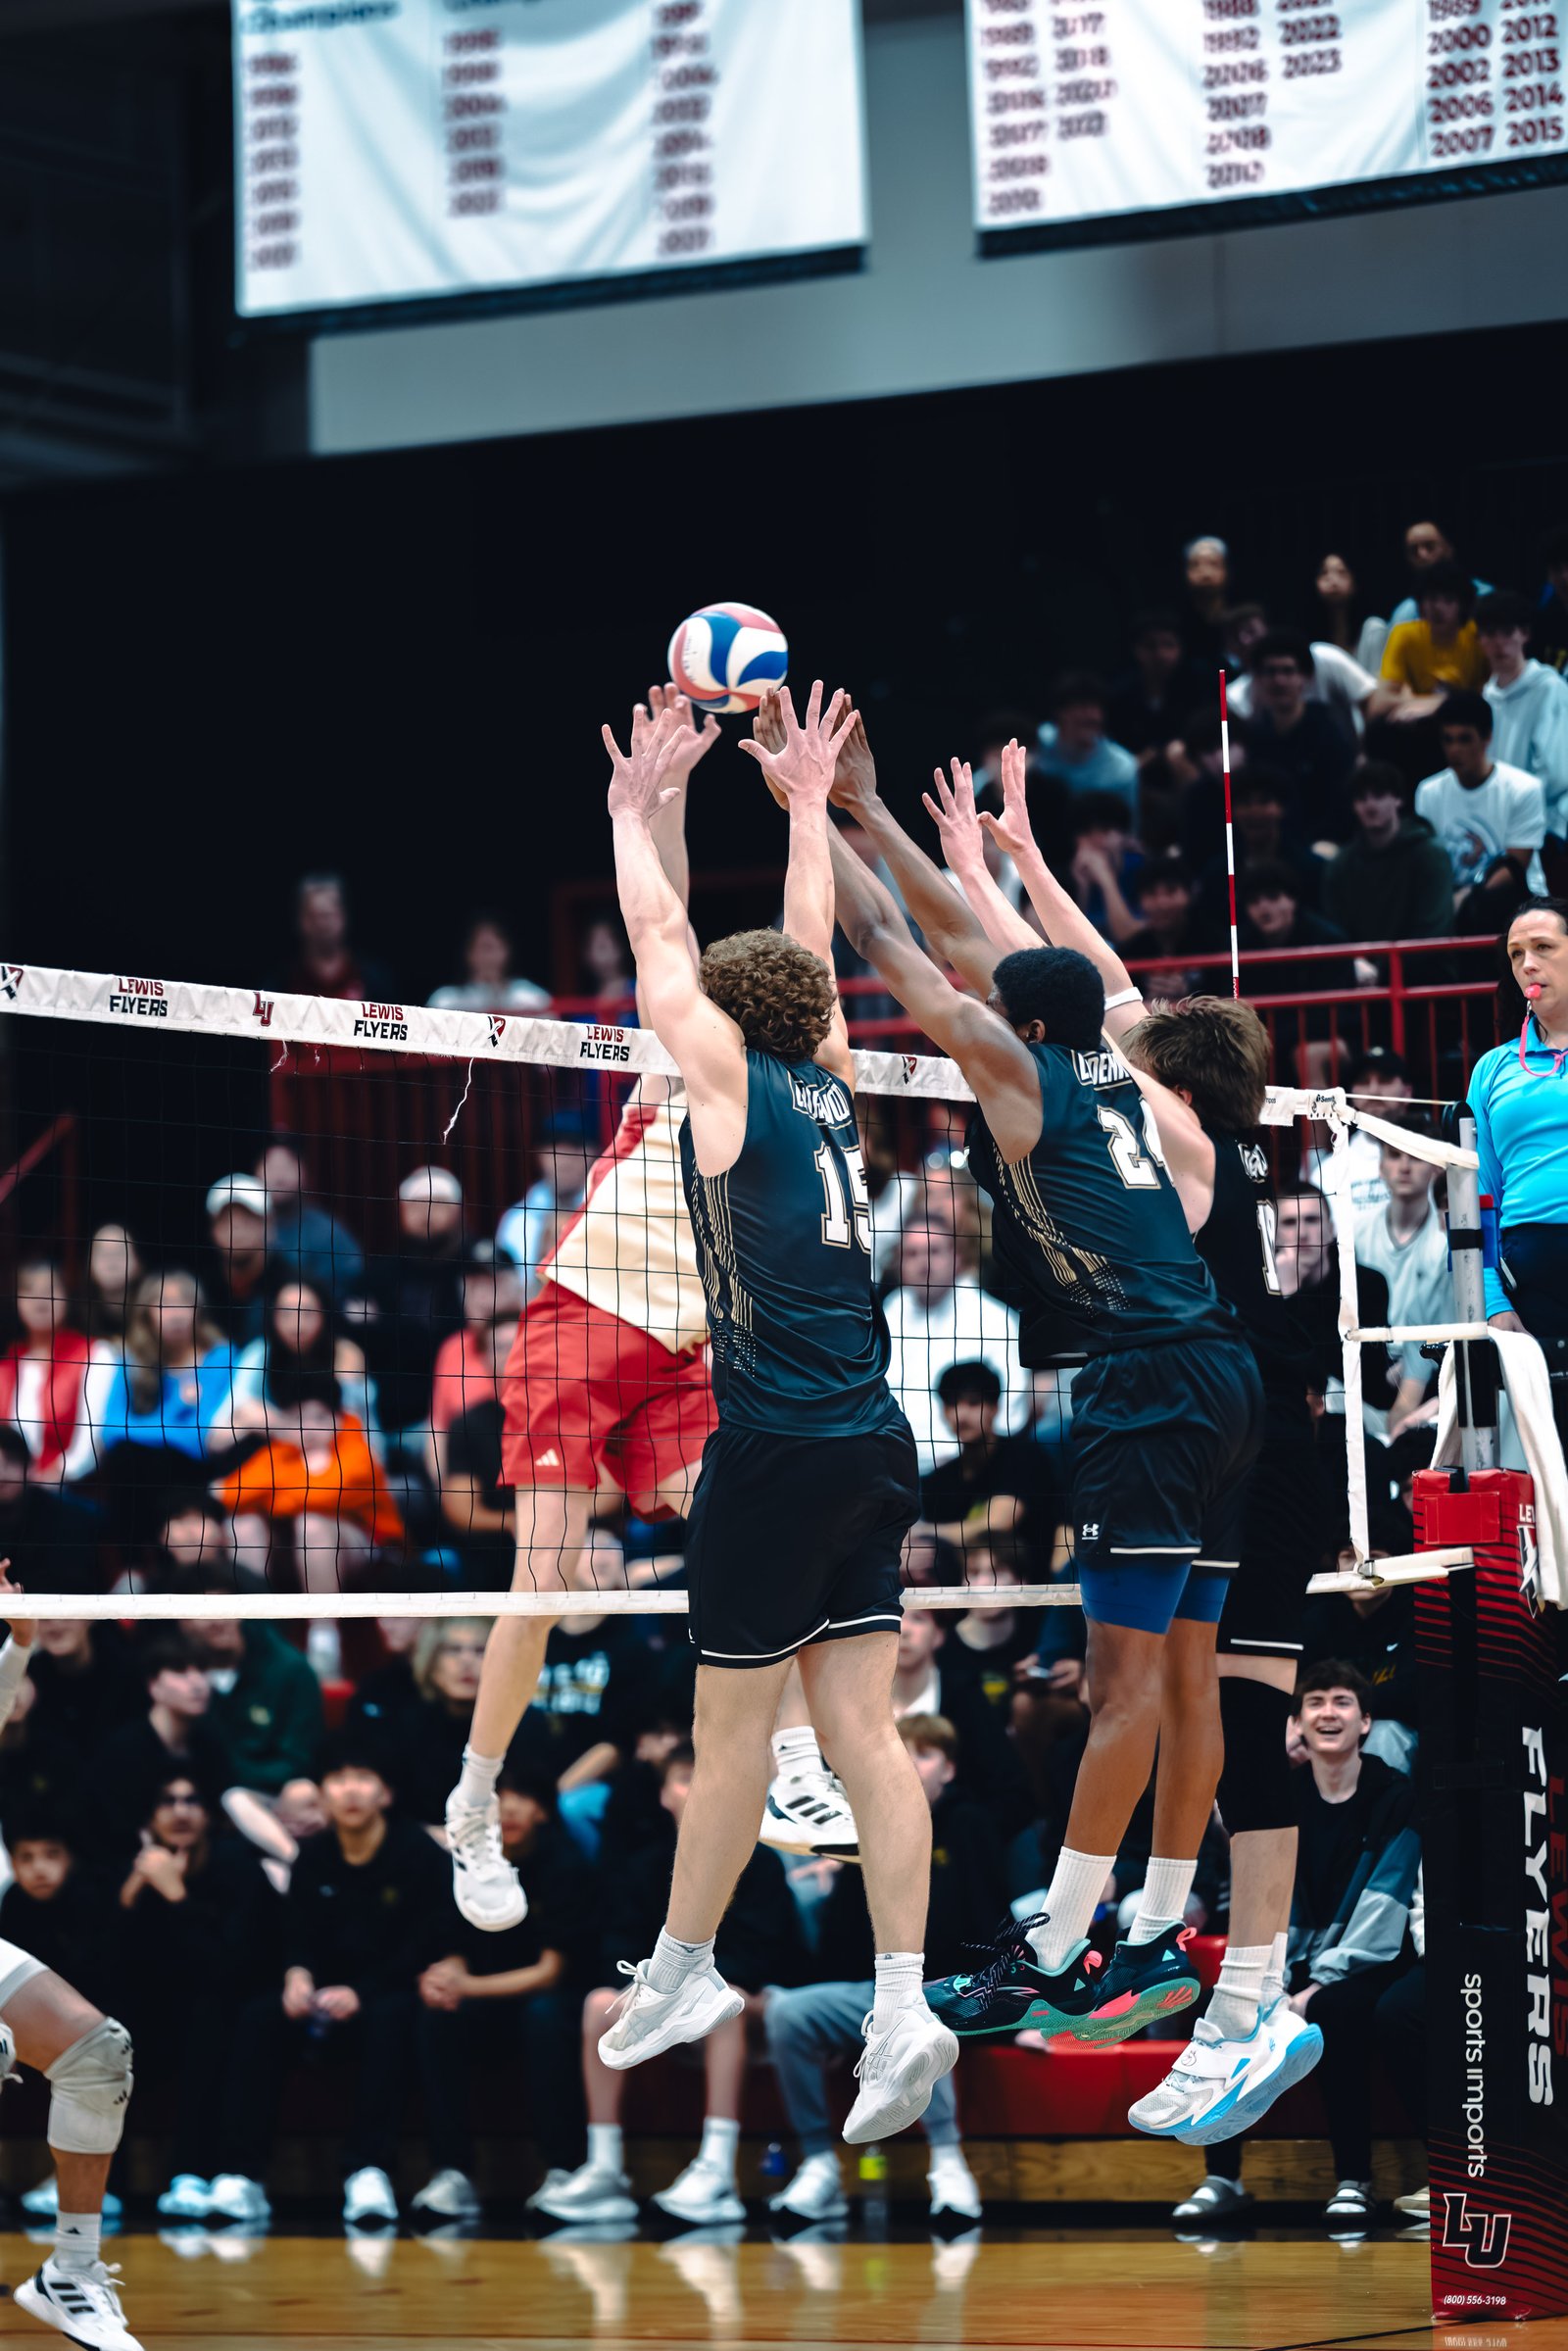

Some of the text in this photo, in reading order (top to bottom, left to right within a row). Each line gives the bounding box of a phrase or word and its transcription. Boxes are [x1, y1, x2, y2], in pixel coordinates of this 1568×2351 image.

[1279, 14, 1341, 46] 2022
[1429, 22, 1492, 55] 2000
[1502, 13, 1559, 44] 2012
[1283, 48, 1342, 79] 2023
[1428, 58, 1490, 90] 2002
[1503, 47, 1561, 78] 2013
[1427, 88, 1494, 124] 2006
[1504, 81, 1564, 112] 2014
[1431, 122, 1495, 157] 2007
[1507, 117, 1564, 147] 2015
[119, 978, 164, 997] LEWIS
[110, 995, 168, 1017] FLYERS
[253, 991, 274, 1027] LU
[362, 1003, 404, 1021] LEWIS
[354, 1019, 409, 1041] FLYERS
[586, 1025, 624, 1043] LEWIS
[580, 1042, 630, 1061] FLYERS
[1522, 1727, 1554, 2106] FLYERS
[1460, 1973, 1488, 2179] sports imports
[1443, 2193, 1512, 2269] LU
[1444, 2295, 1506, 2305] (800) 556-3198
